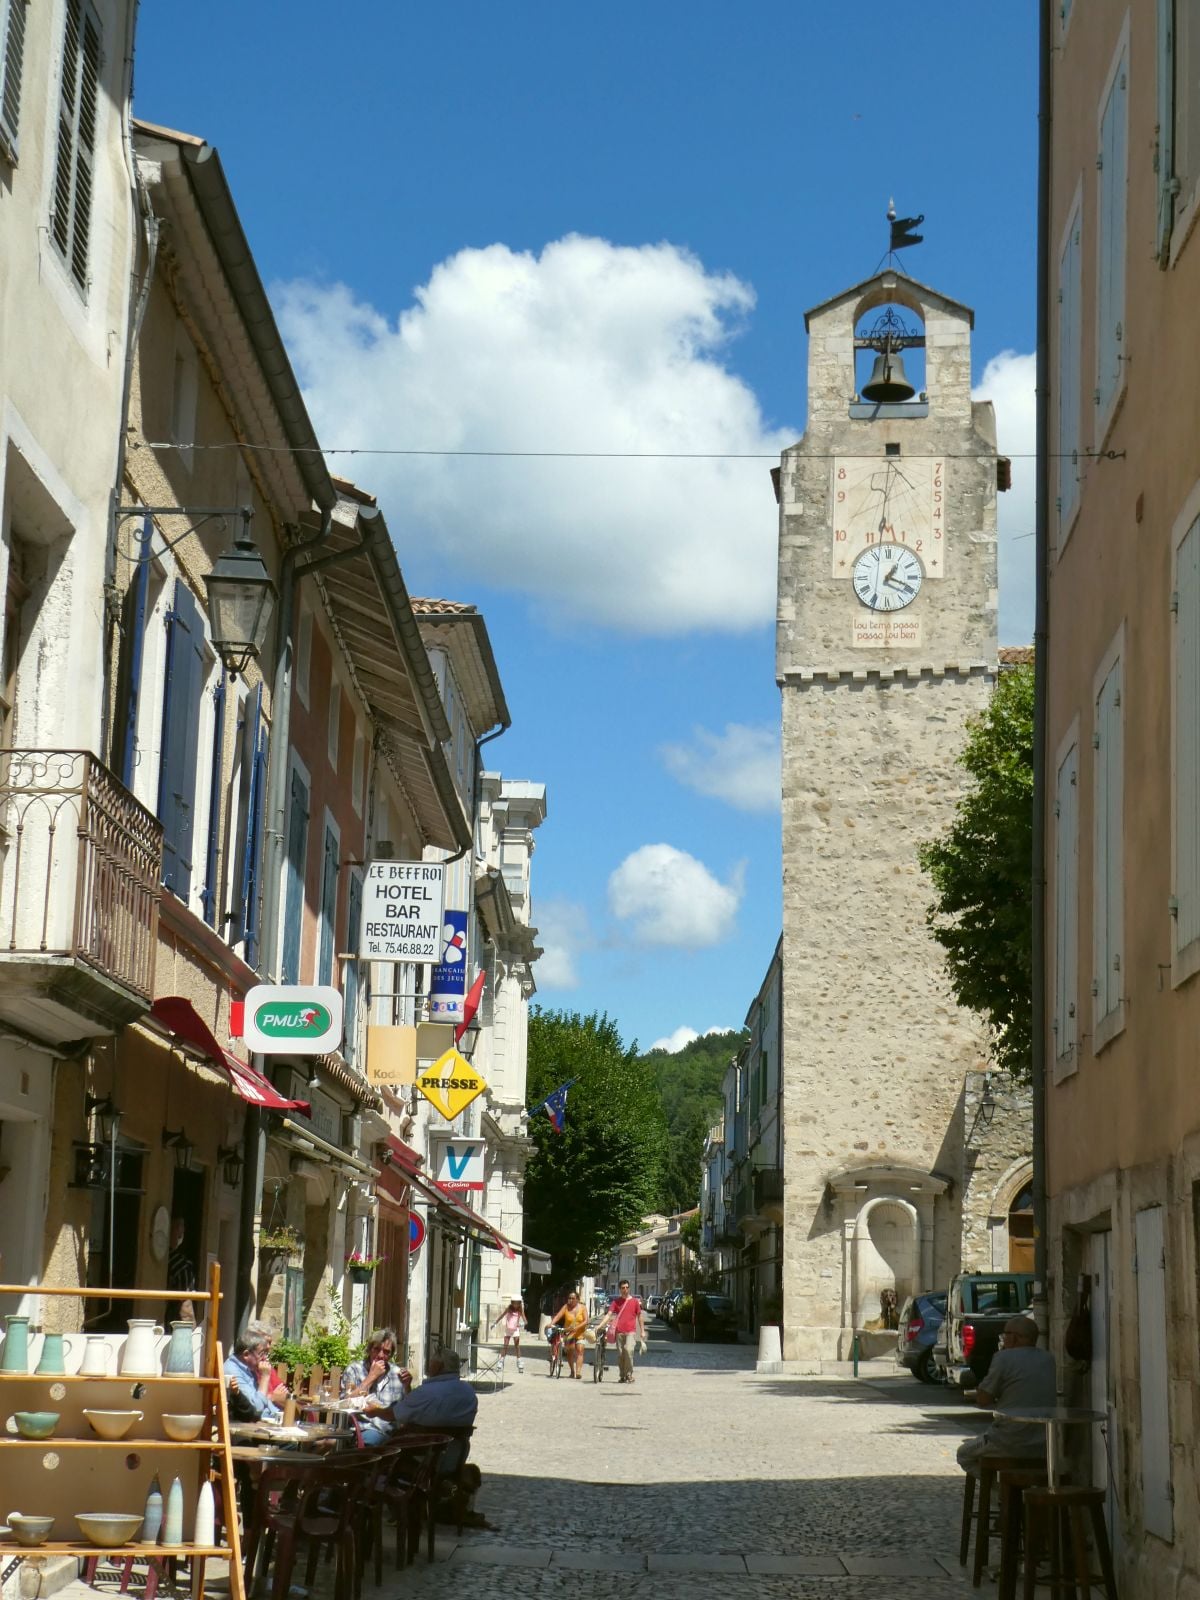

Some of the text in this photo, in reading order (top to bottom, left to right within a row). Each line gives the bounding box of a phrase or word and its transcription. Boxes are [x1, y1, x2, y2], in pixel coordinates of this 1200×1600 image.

[837, 468, 846, 480] 8
[935, 463, 942, 474] 7
[934, 476, 942, 487] 6
[837, 491, 846, 503] 9
[934, 491, 942, 502] 5
[933, 508, 942, 519] 4
[835, 530, 846, 541] 10
[865, 532, 874, 543] 11
[900, 530, 905, 542] 1
[934, 528, 942, 540] 3
[916, 540, 922, 552] 2
[370, 866, 442, 880] LE BEFFROI
[376, 884, 432, 900] HOTEL
[386, 904, 420, 919] BAR
[366, 922, 438, 939] RESTAURANT
[368, 942, 434, 955] Tel. 75.46.88.22
[262, 1014, 298, 1027] PMU
[422, 1078, 478, 1090] PRESSE
